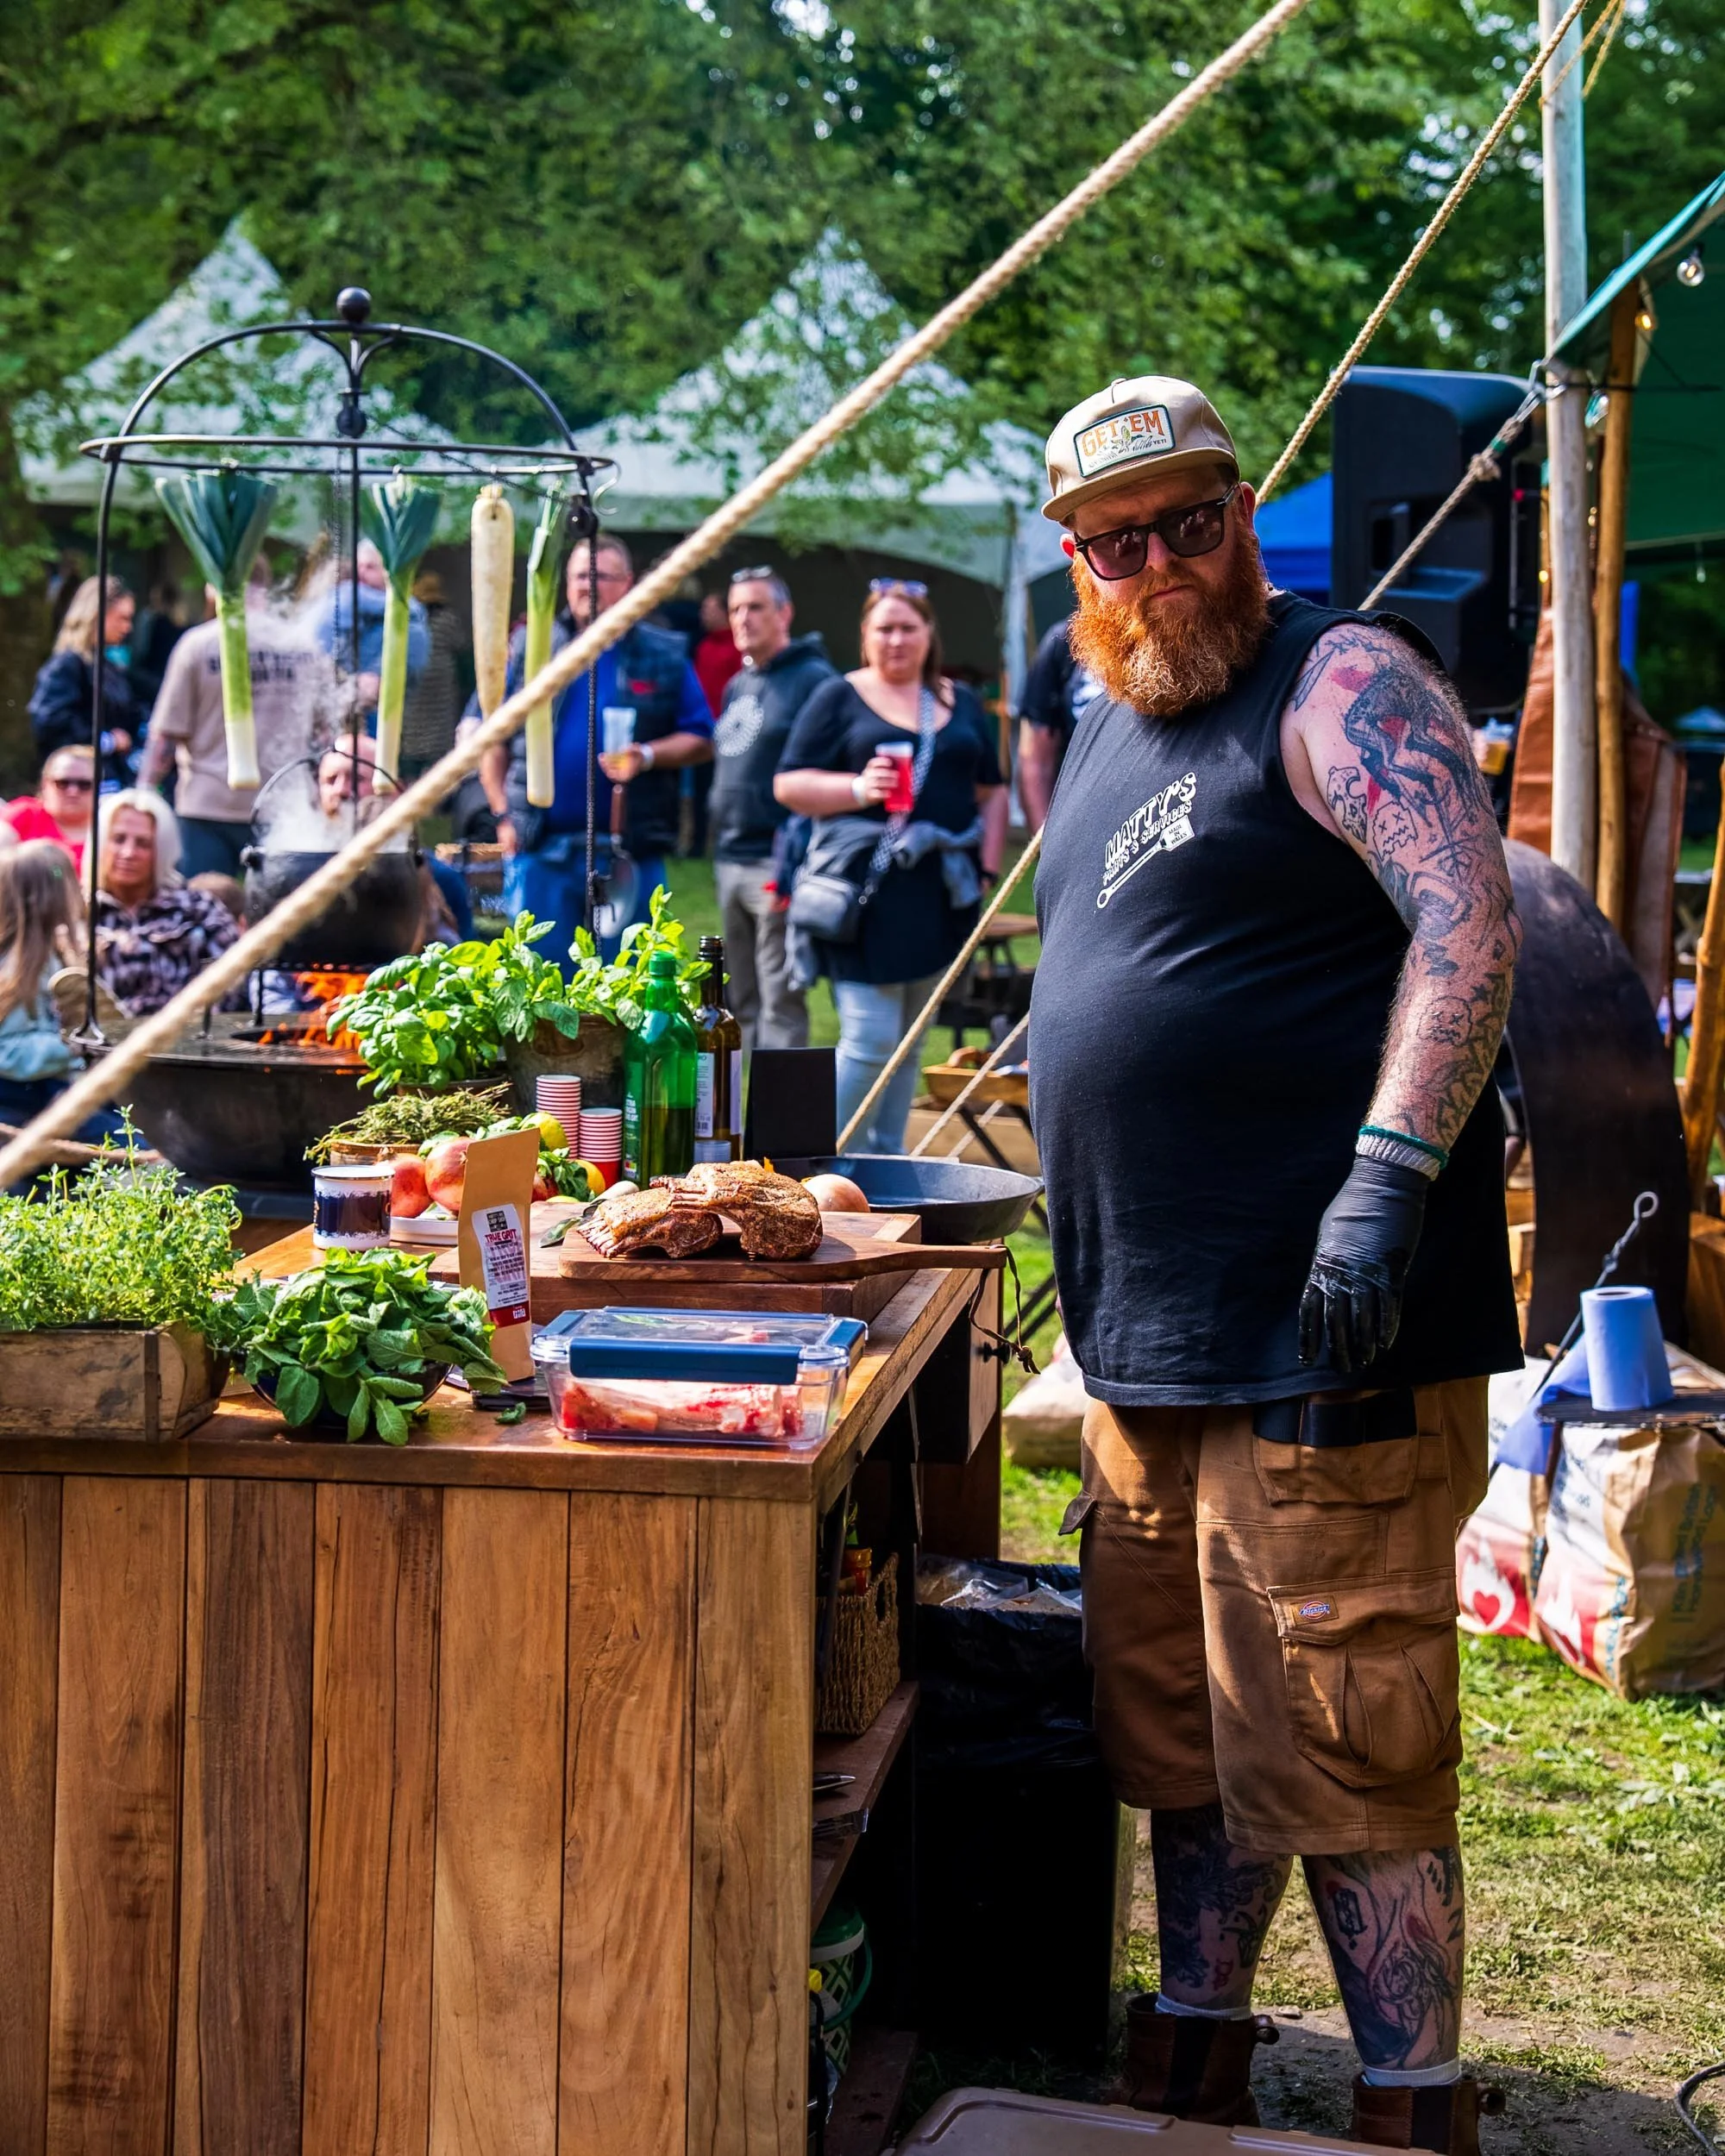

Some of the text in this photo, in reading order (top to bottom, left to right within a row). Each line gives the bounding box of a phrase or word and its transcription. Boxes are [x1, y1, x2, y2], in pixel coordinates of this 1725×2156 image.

[1082, 420, 1120, 457] GET
[1124, 410, 1165, 436] 'EM
[1105, 772, 1197, 870] MATTY'S
[1140, 799, 1192, 844] SERVICES
[1168, 824, 1182, 835] MADE
[1170, 832, 1188, 845] WALES
[485, 1232, 502, 1243] TRUE
[501, 1228, 518, 1240] GRIT
